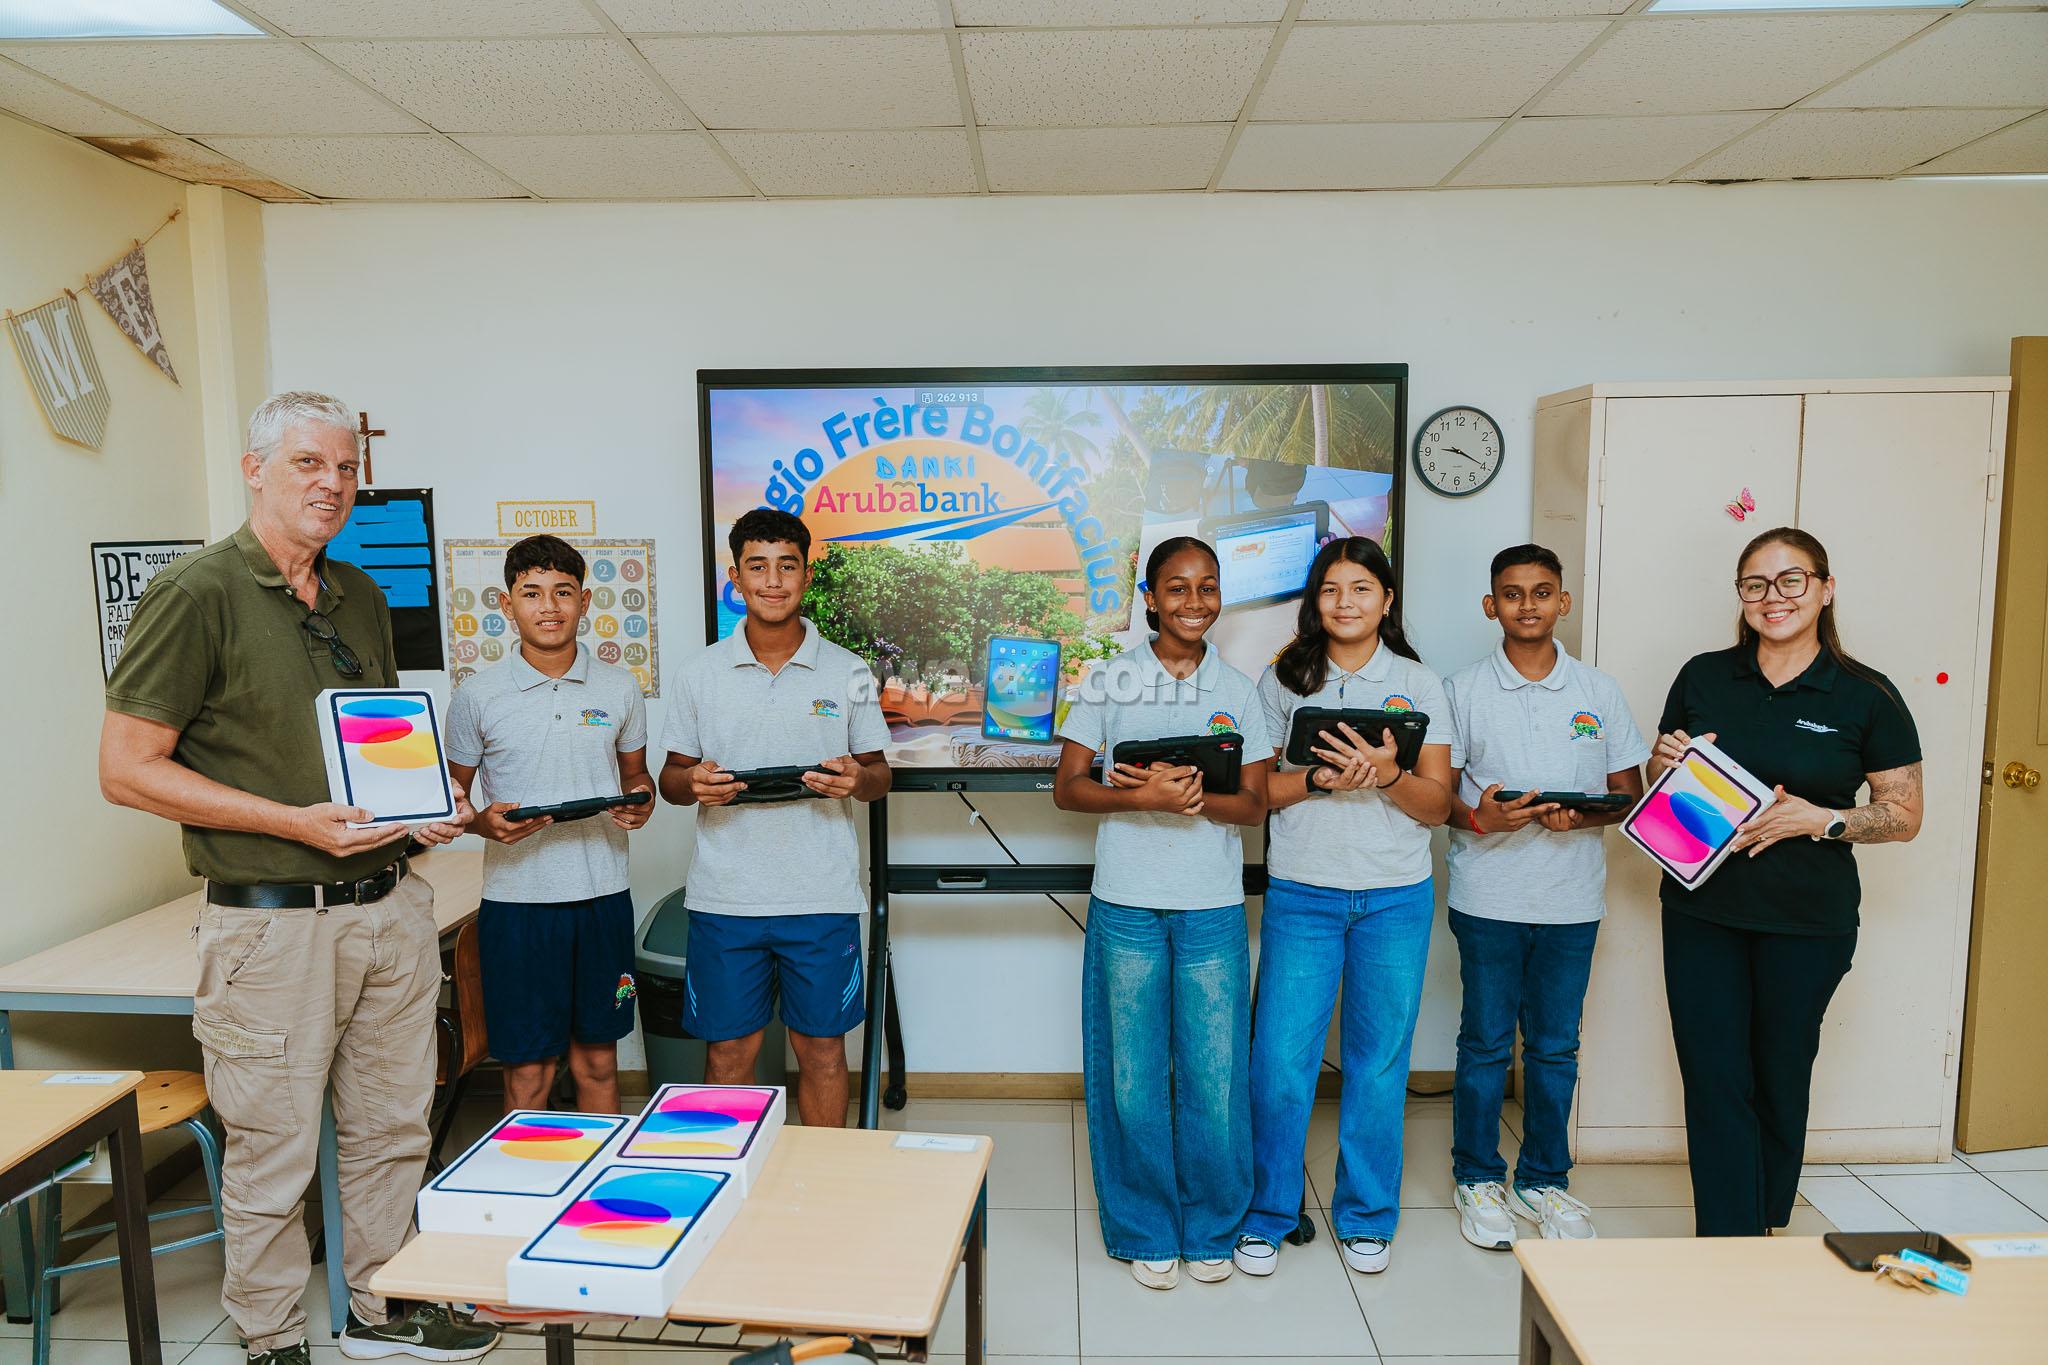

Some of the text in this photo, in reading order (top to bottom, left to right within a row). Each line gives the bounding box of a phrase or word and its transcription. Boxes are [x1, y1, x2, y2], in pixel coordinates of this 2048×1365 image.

[937, 393, 978, 402] 262 913
[1440, 422, 1450, 431] 11
[1455, 417, 1465, 426] 12
[1429, 432, 1440, 442] 10
[1482, 432, 1488, 441] 2
[1425, 447, 1431, 456] 9
[1486, 447, 1491, 456] 3
[875, 454, 976, 480] DANKI
[1429, 462, 1435, 471] 8
[1480, 462, 1486, 471] 4
[1440, 473, 1446, 482] 7
[1454, 476, 1460, 485] 6
[1469, 472, 1475, 481] 5
[814, 482, 1001, 514] Arubabank
[822, 396, 949, 460] Frère
[960, 401, 1121, 614] Bonifacius
[515, 509, 578, 528] OCTOBER
[599, 564, 636, 578] 2 3
[100, 552, 143, 603] BE
[457, 591, 498, 607] 4 5
[598, 591, 642, 607] 9 10
[457, 617, 503, 632] 11 12
[597, 618, 614, 633] 16
[627, 619, 642, 633] 17
[458, 642, 501, 660] 18 19
[600, 646, 644, 661] 23 24
